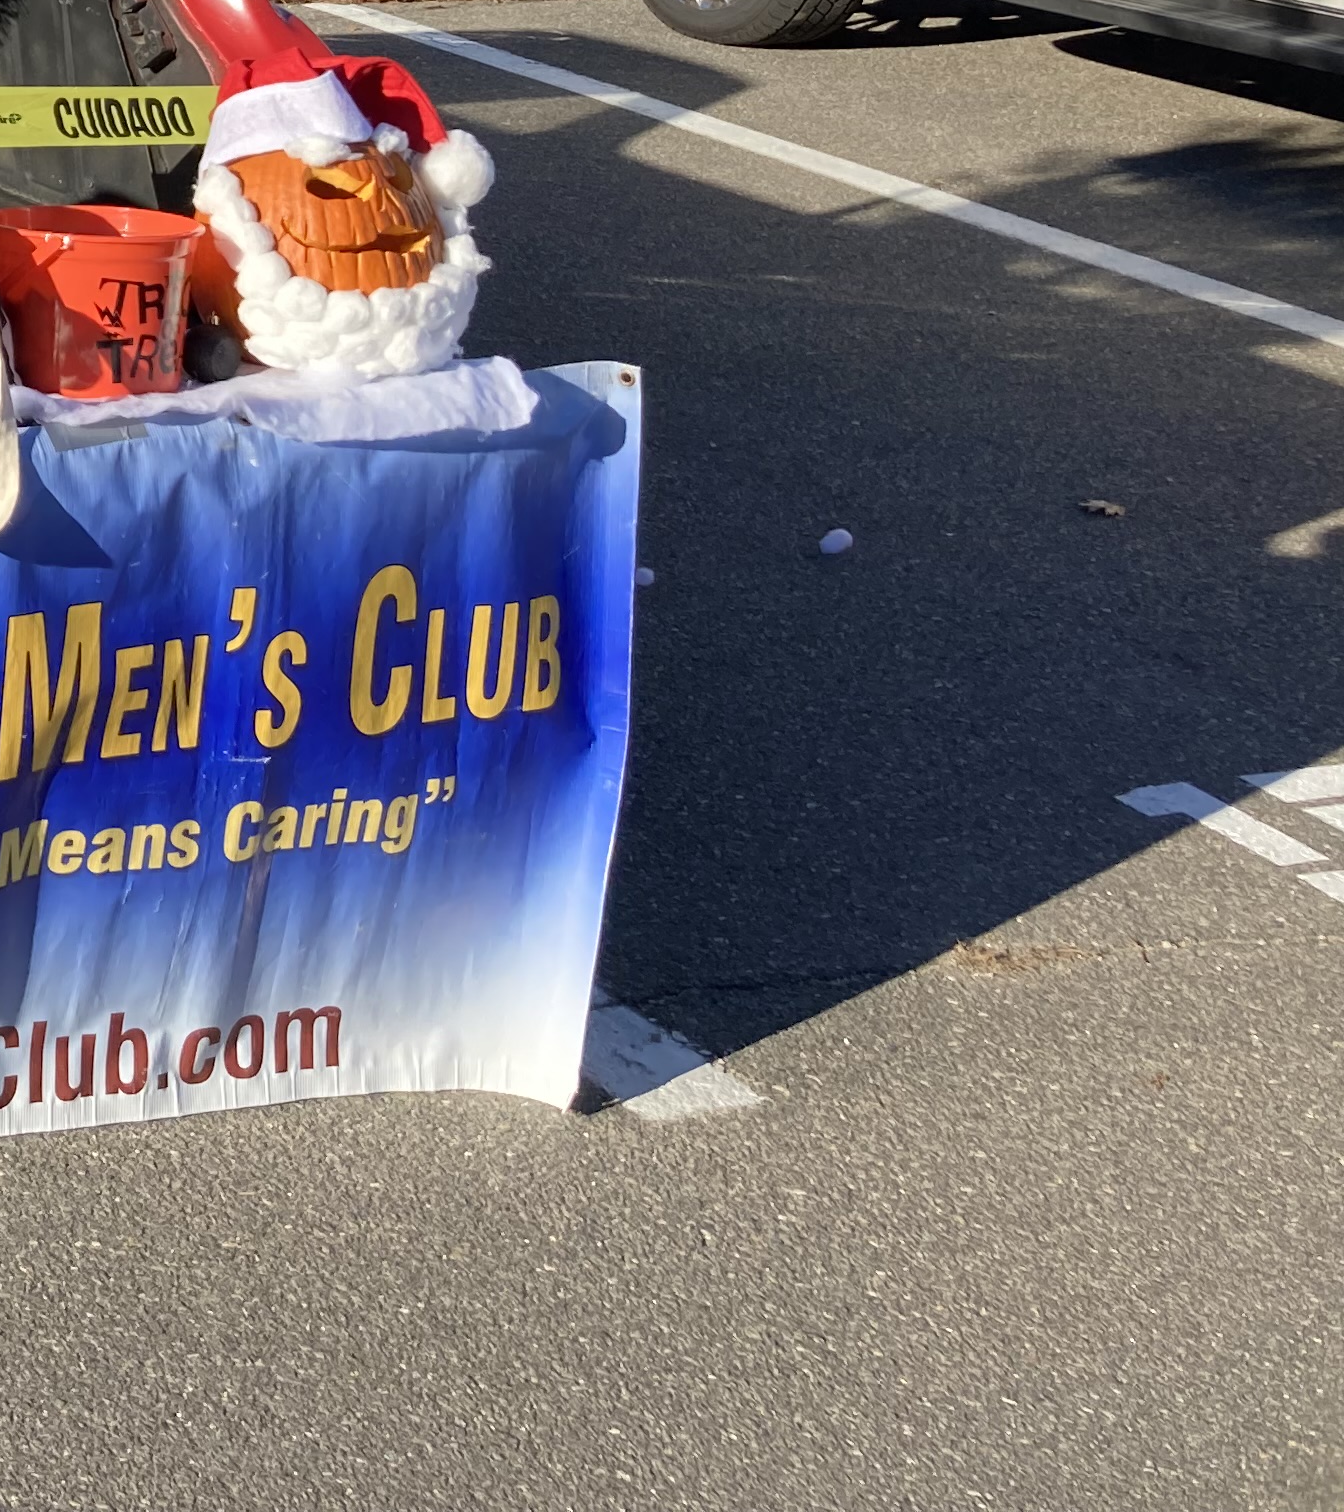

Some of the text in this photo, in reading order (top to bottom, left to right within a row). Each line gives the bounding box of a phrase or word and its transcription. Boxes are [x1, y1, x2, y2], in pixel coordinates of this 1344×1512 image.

[53, 96, 196, 139] CUIDADO
[349, 562, 562, 737] CLUB
[223, 775, 457, 864] Caring"
